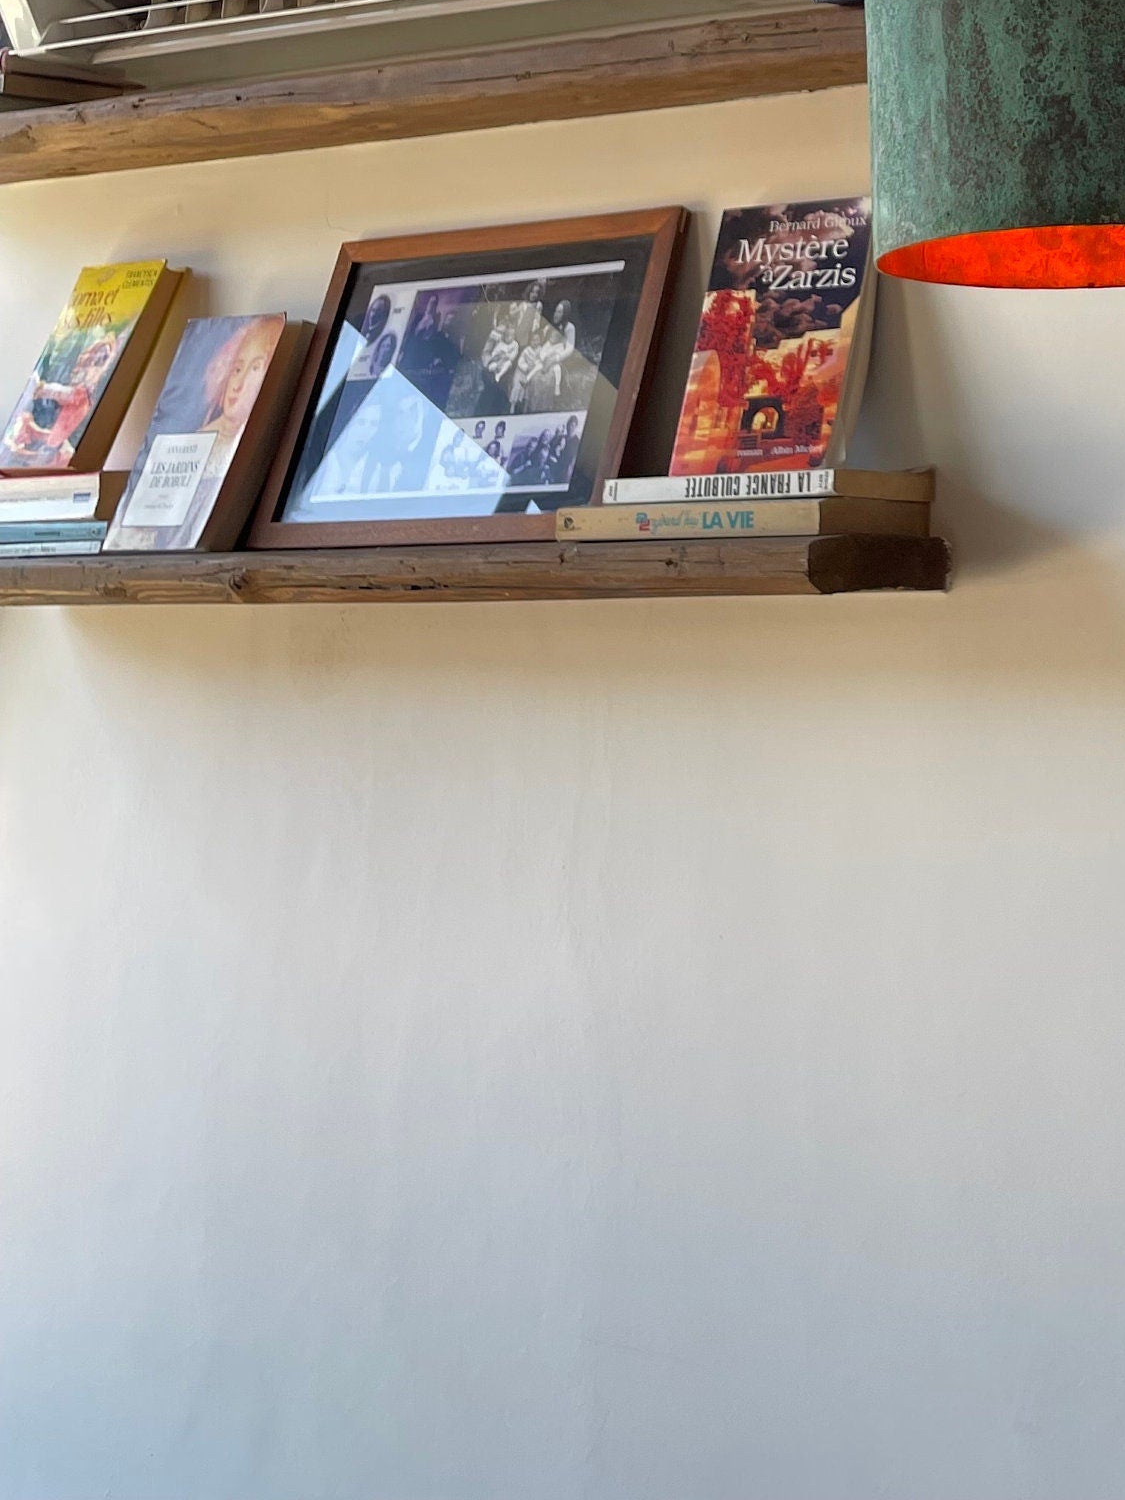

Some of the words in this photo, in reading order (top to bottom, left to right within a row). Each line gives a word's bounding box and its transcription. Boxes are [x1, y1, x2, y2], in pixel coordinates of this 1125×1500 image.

[769, 217, 822, 234] Bernard
[736, 234, 850, 269] Mystère
[760, 264, 774, 283] à
[769, 263, 858, 290] Zarzis
[745, 473, 791, 496] FRANCE
[797, 472, 812, 494] LA
[702, 511, 724, 529] LA
[726, 510, 755, 529] VIE
